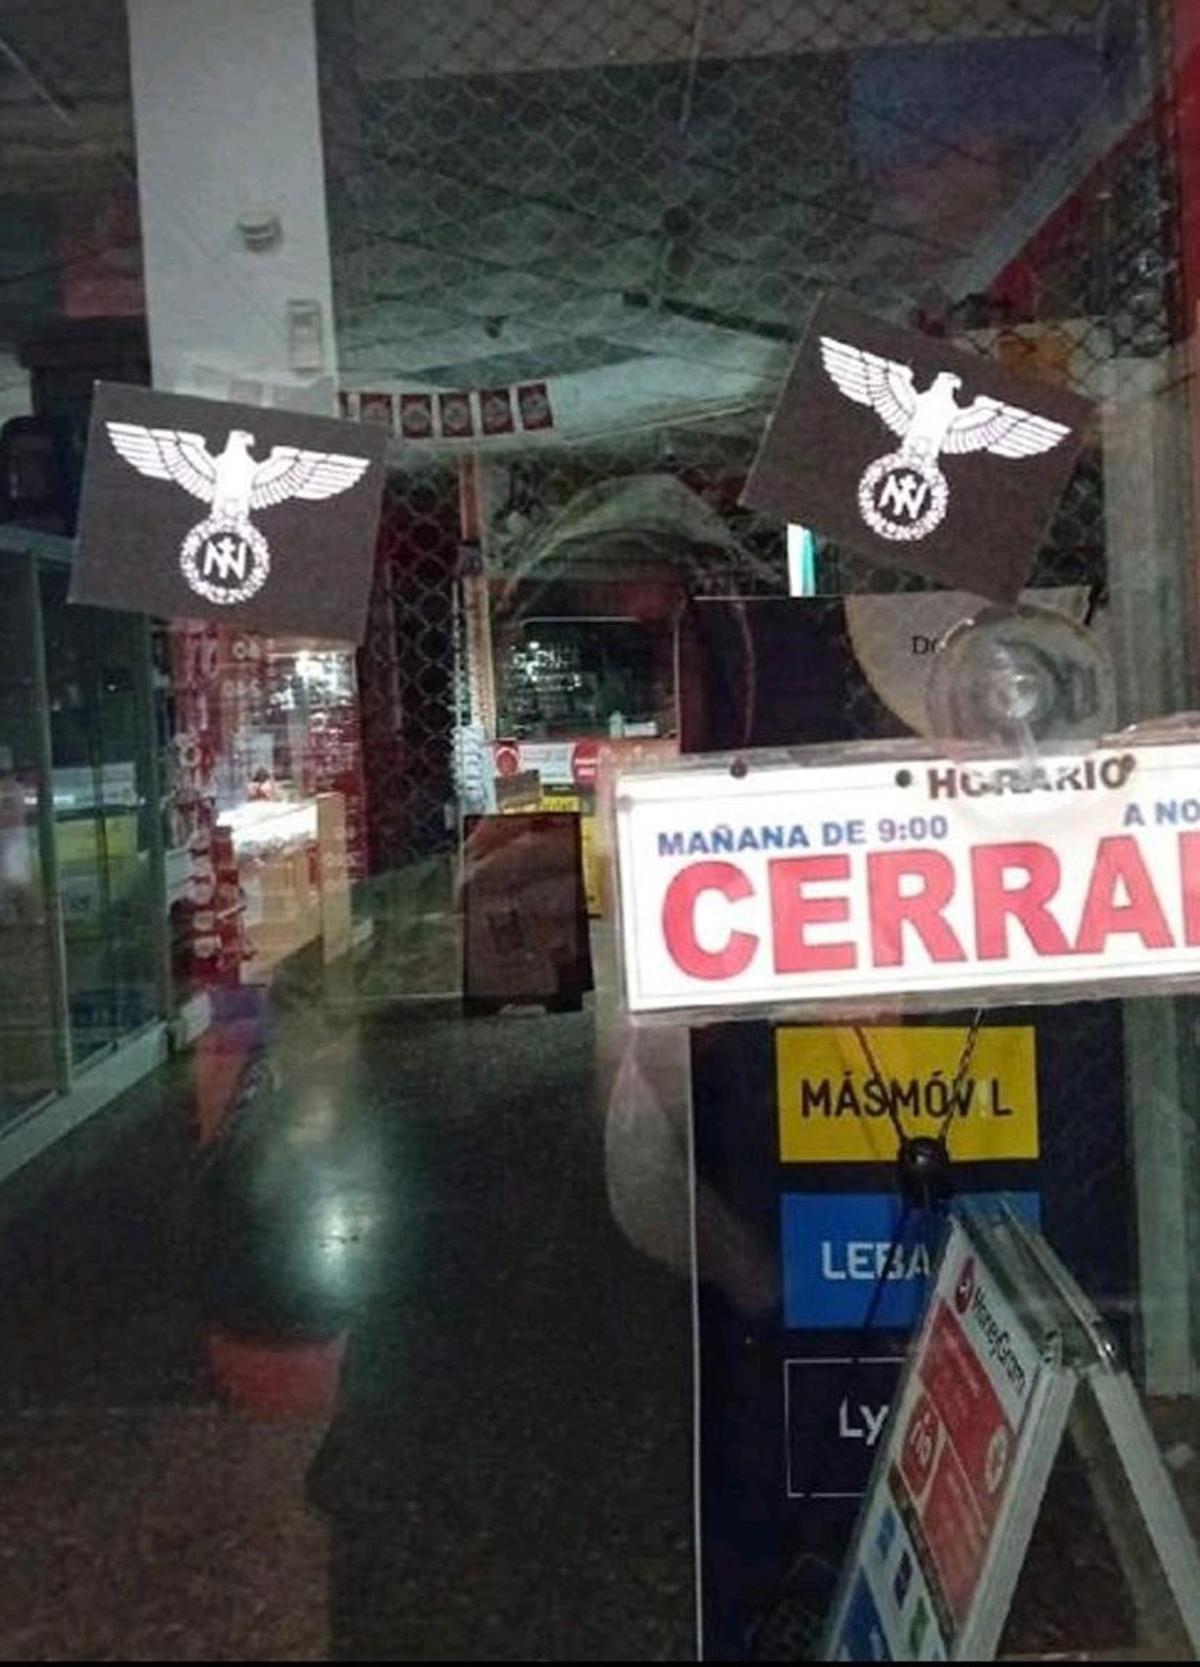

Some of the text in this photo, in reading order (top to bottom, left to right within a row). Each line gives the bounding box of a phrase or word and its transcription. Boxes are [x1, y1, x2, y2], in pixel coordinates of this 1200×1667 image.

[657, 824, 811, 857] MAÑANA
[822, 819, 867, 847] DE
[878, 815, 949, 842] 9:00
[1123, 802, 1146, 827] A
[839, 1396, 889, 1446] Ly
